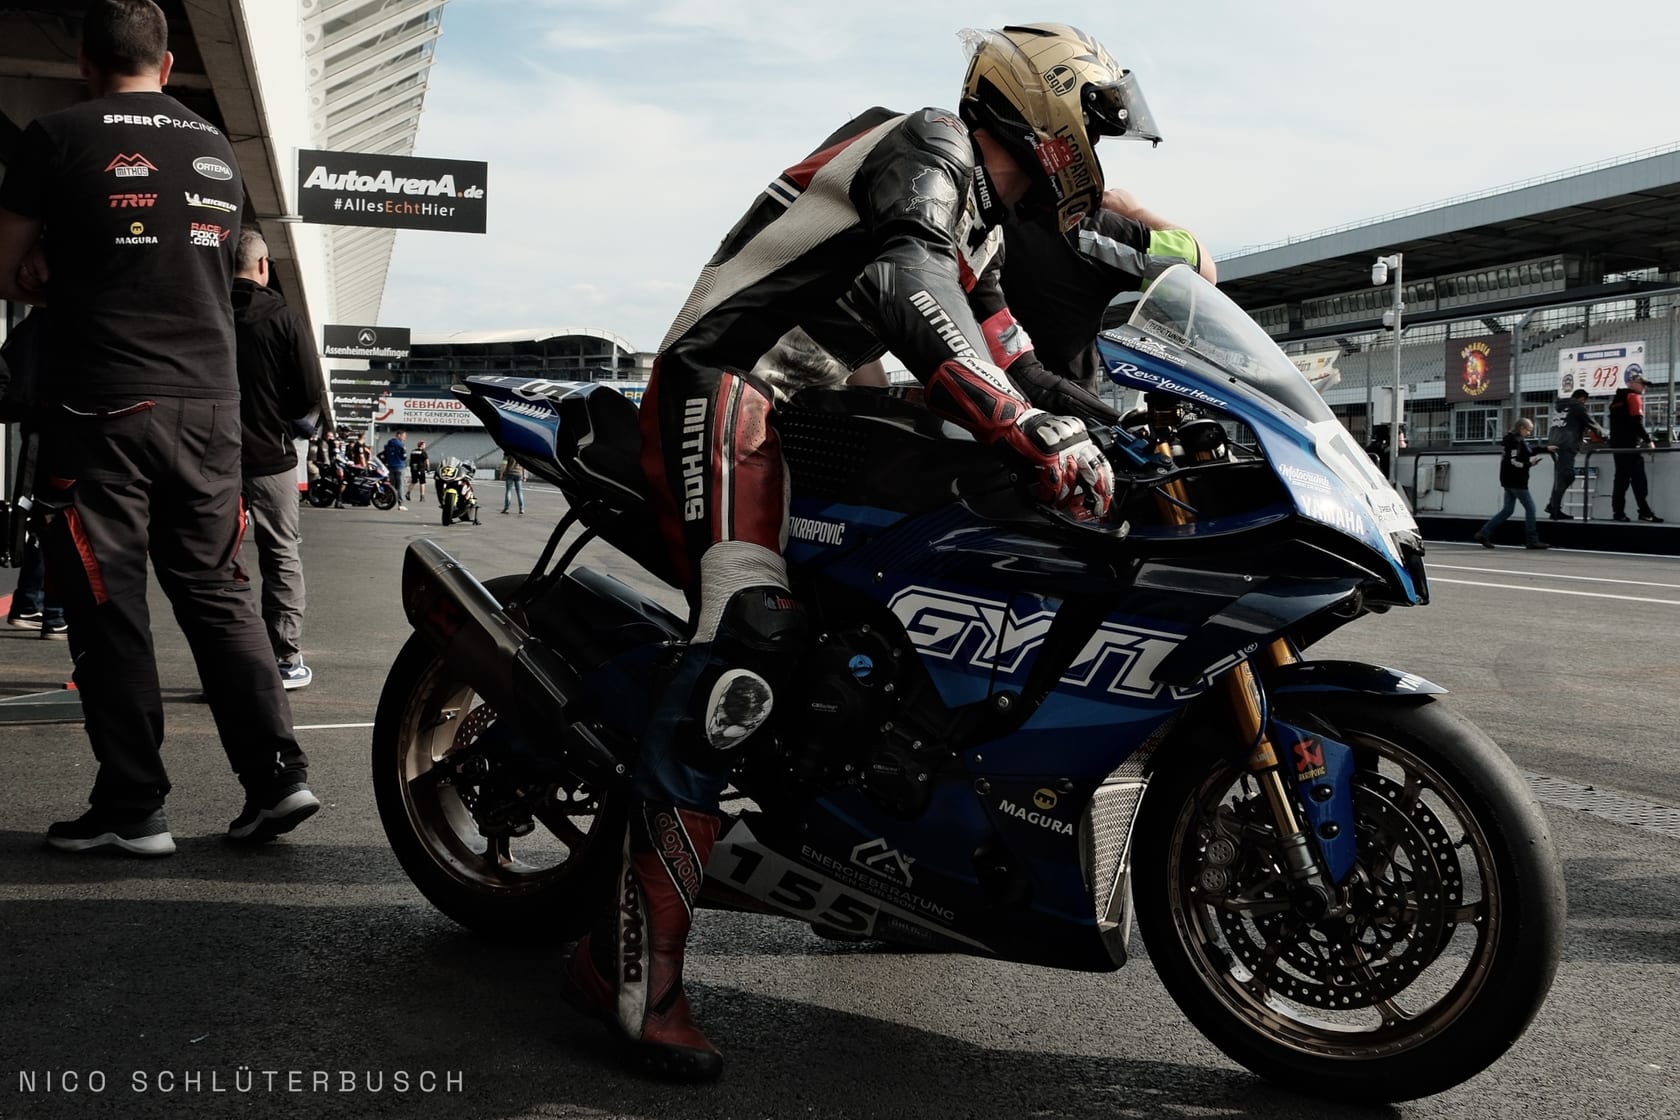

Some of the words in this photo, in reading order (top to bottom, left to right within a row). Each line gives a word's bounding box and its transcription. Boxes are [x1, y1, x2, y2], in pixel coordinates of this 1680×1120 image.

[103, 114, 153, 126] SPEER
[172, 118, 220, 136] RACING
[116, 167, 149, 177] MITHOS
[196, 162, 231, 176] ORTEMA
[303, 166, 485, 199] AutoArenA.de
[974, 165, 993, 211] MITHOS
[108, 194, 159, 209] TRW
[334, 198, 456, 217] #AllesEchtHier
[190, 230, 219, 241] FOXX
[191, 222, 222, 234] RACE
[115, 236, 159, 245] MAGURA
[1111, 361, 1161, 382] Revs
[1156, 377, 1193, 393] Your
[1189, 388, 1228, 407] Heart
[1593, 365, 1619, 388] 973
[404, 400, 467, 410] GEBHARD
[499, 400, 553, 420] YAMAHA
[403, 417, 470, 425] INTRALOGISTICS
[681, 397, 708, 522] MITHOS
[1301, 495, 1365, 536] YAMAHA
[999, 799, 1074, 837] MAGURA
[730, 843, 875, 934] 155
[801, 844, 957, 921] ENERGIEBERATUNG
